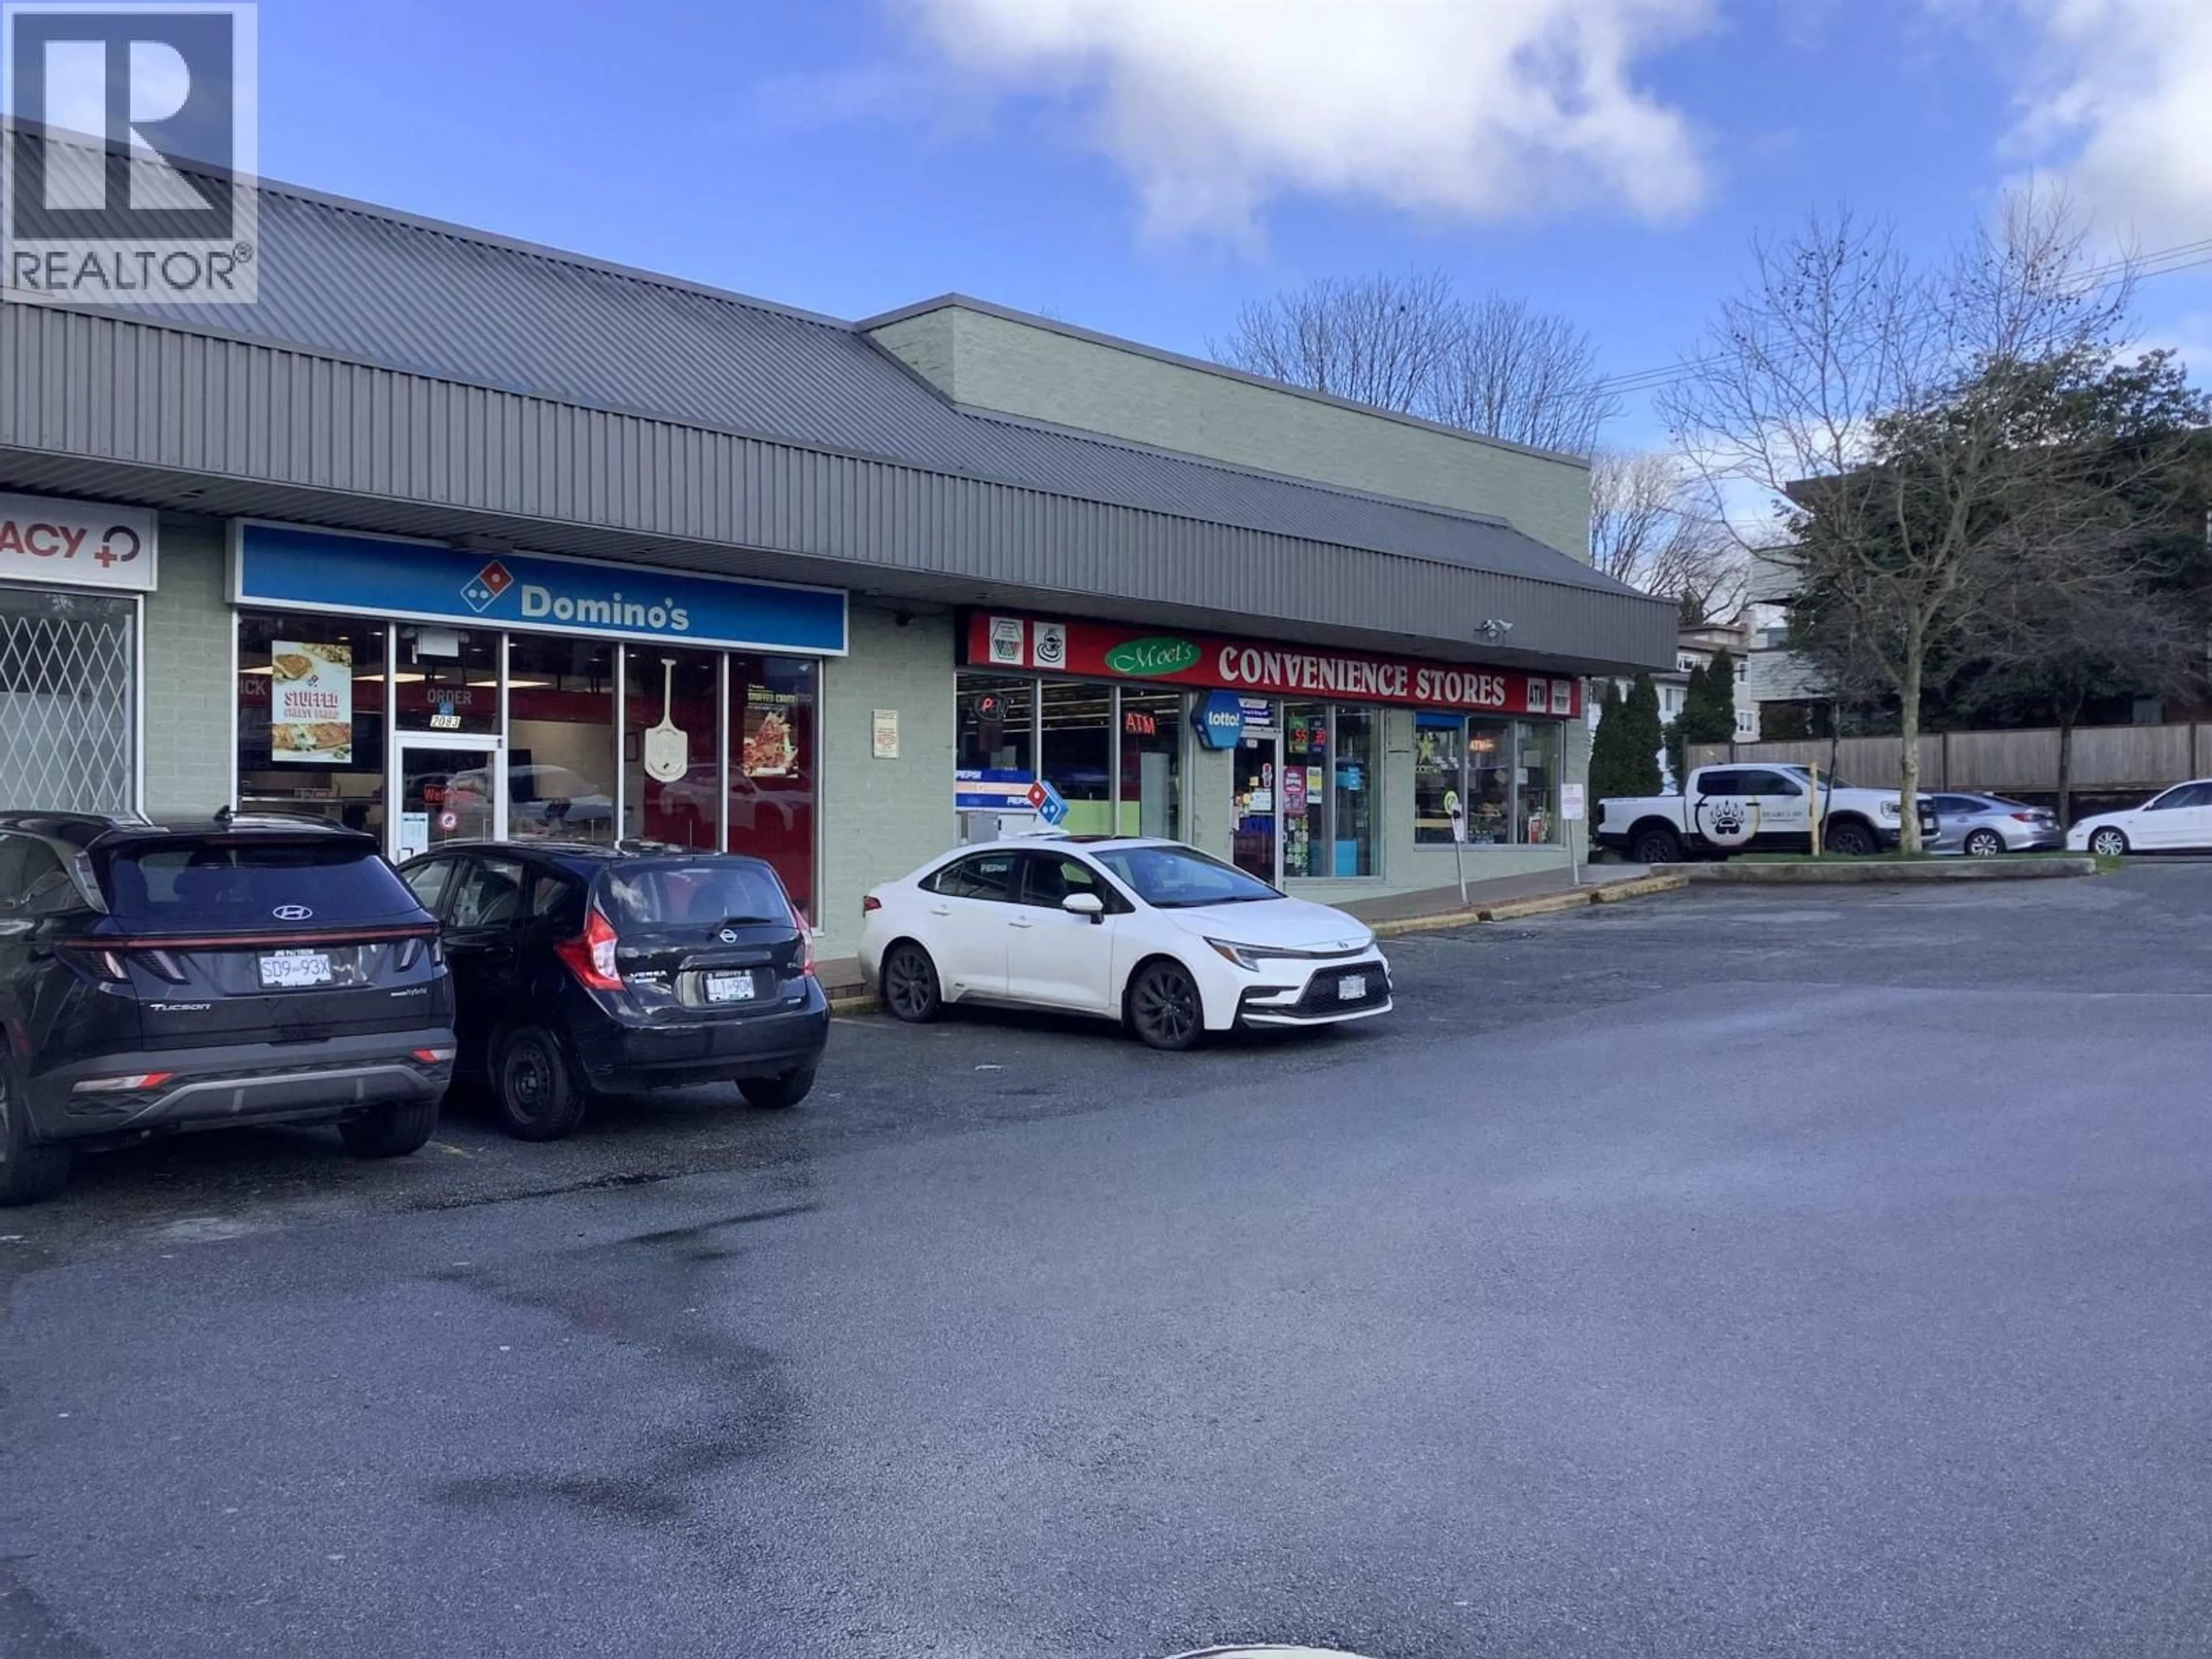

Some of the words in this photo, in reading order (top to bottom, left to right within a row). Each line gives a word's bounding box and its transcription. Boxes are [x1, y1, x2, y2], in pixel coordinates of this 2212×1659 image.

[521, 584, 690, 631] Domino's
[1218, 646, 1408, 696] CONVENIENCE
[1415, 668, 1506, 707] STORES
[426, 688, 472, 705] ORDER
[1126, 712, 1156, 736] ATM
